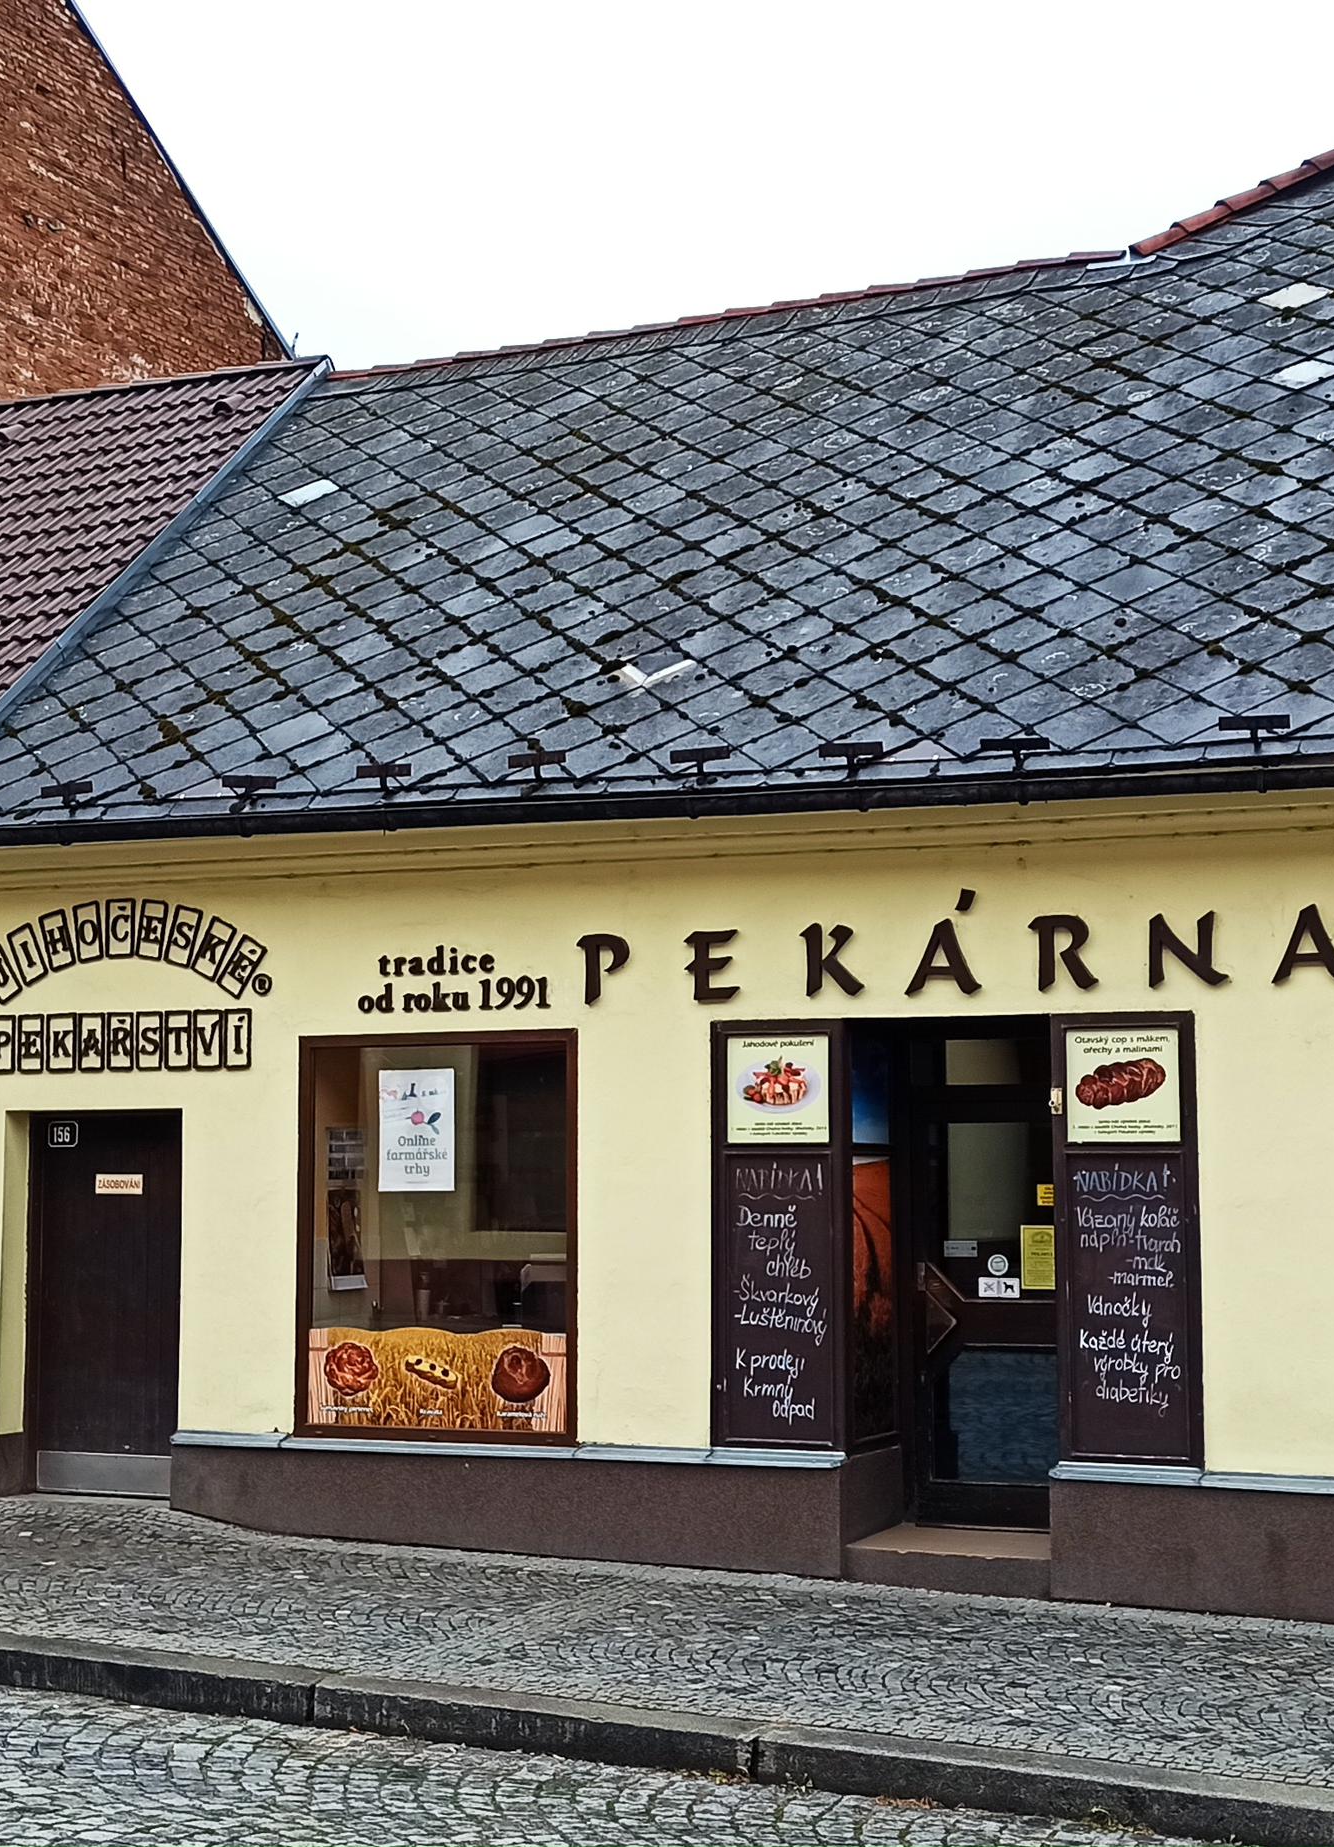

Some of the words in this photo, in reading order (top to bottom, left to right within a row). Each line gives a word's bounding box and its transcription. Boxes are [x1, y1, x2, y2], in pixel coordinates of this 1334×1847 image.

[377, 944, 495, 977] tradice
[357, 982, 395, 1014] od
[402, 981, 471, 1013] roku
[478, 975, 551, 1011] 1991
[1112, 1036, 1127, 1045] cop
[53, 1126, 70, 1143] 156
[398, 1134, 436, 1147] Online
[387, 1148, 448, 1161] farmářské
[405, 1163, 430, 1176] trhy
[736, 1205, 798, 1228] Denně
[748, 1228, 796, 1258] teplý
[1080, 1328, 1126, 1351] Každé
[736, 1347, 746, 1369] K
[1155, 1364, 1181, 1384] pro
